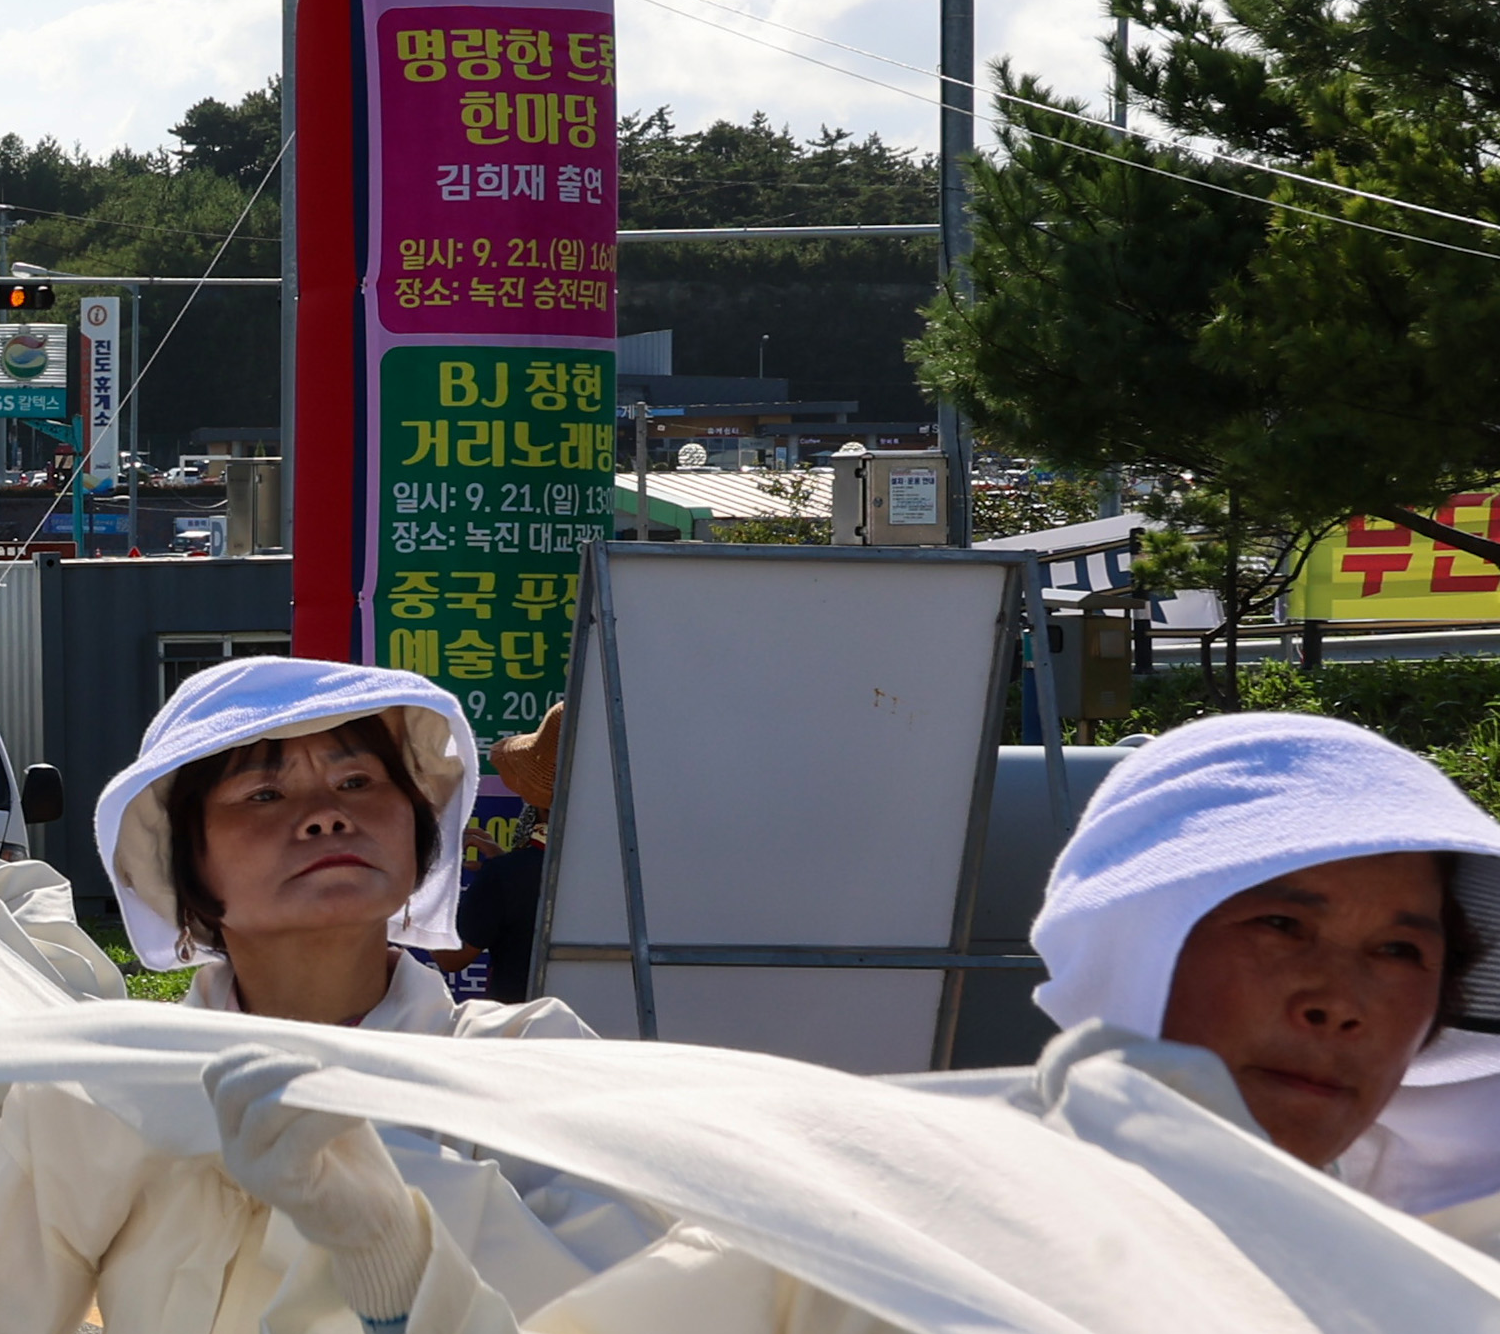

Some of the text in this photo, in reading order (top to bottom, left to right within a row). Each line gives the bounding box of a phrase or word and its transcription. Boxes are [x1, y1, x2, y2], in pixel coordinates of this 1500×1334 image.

[396, 28, 553, 83] 명량한
[460, 91, 597, 148] 한마당
[436, 164, 603, 205] 김희재 출연
[399, 239, 463, 271] 일시:
[394, 277, 608, 312] 장소: 녹진 승전무대
[17, 394, 60, 411] 칼텍스
[93, 339, 112, 427] 진도휴게소
[439, 361, 602, 413] BJ 창현
[400, 419, 614, 473] 거리노래방
[393, 482, 456, 513] 일시:
[392, 523, 455, 554] 장소:
[465, 523, 520, 552] 녹진
[387, 572, 497, 620] 중국
[389, 629, 548, 679] 예술단
